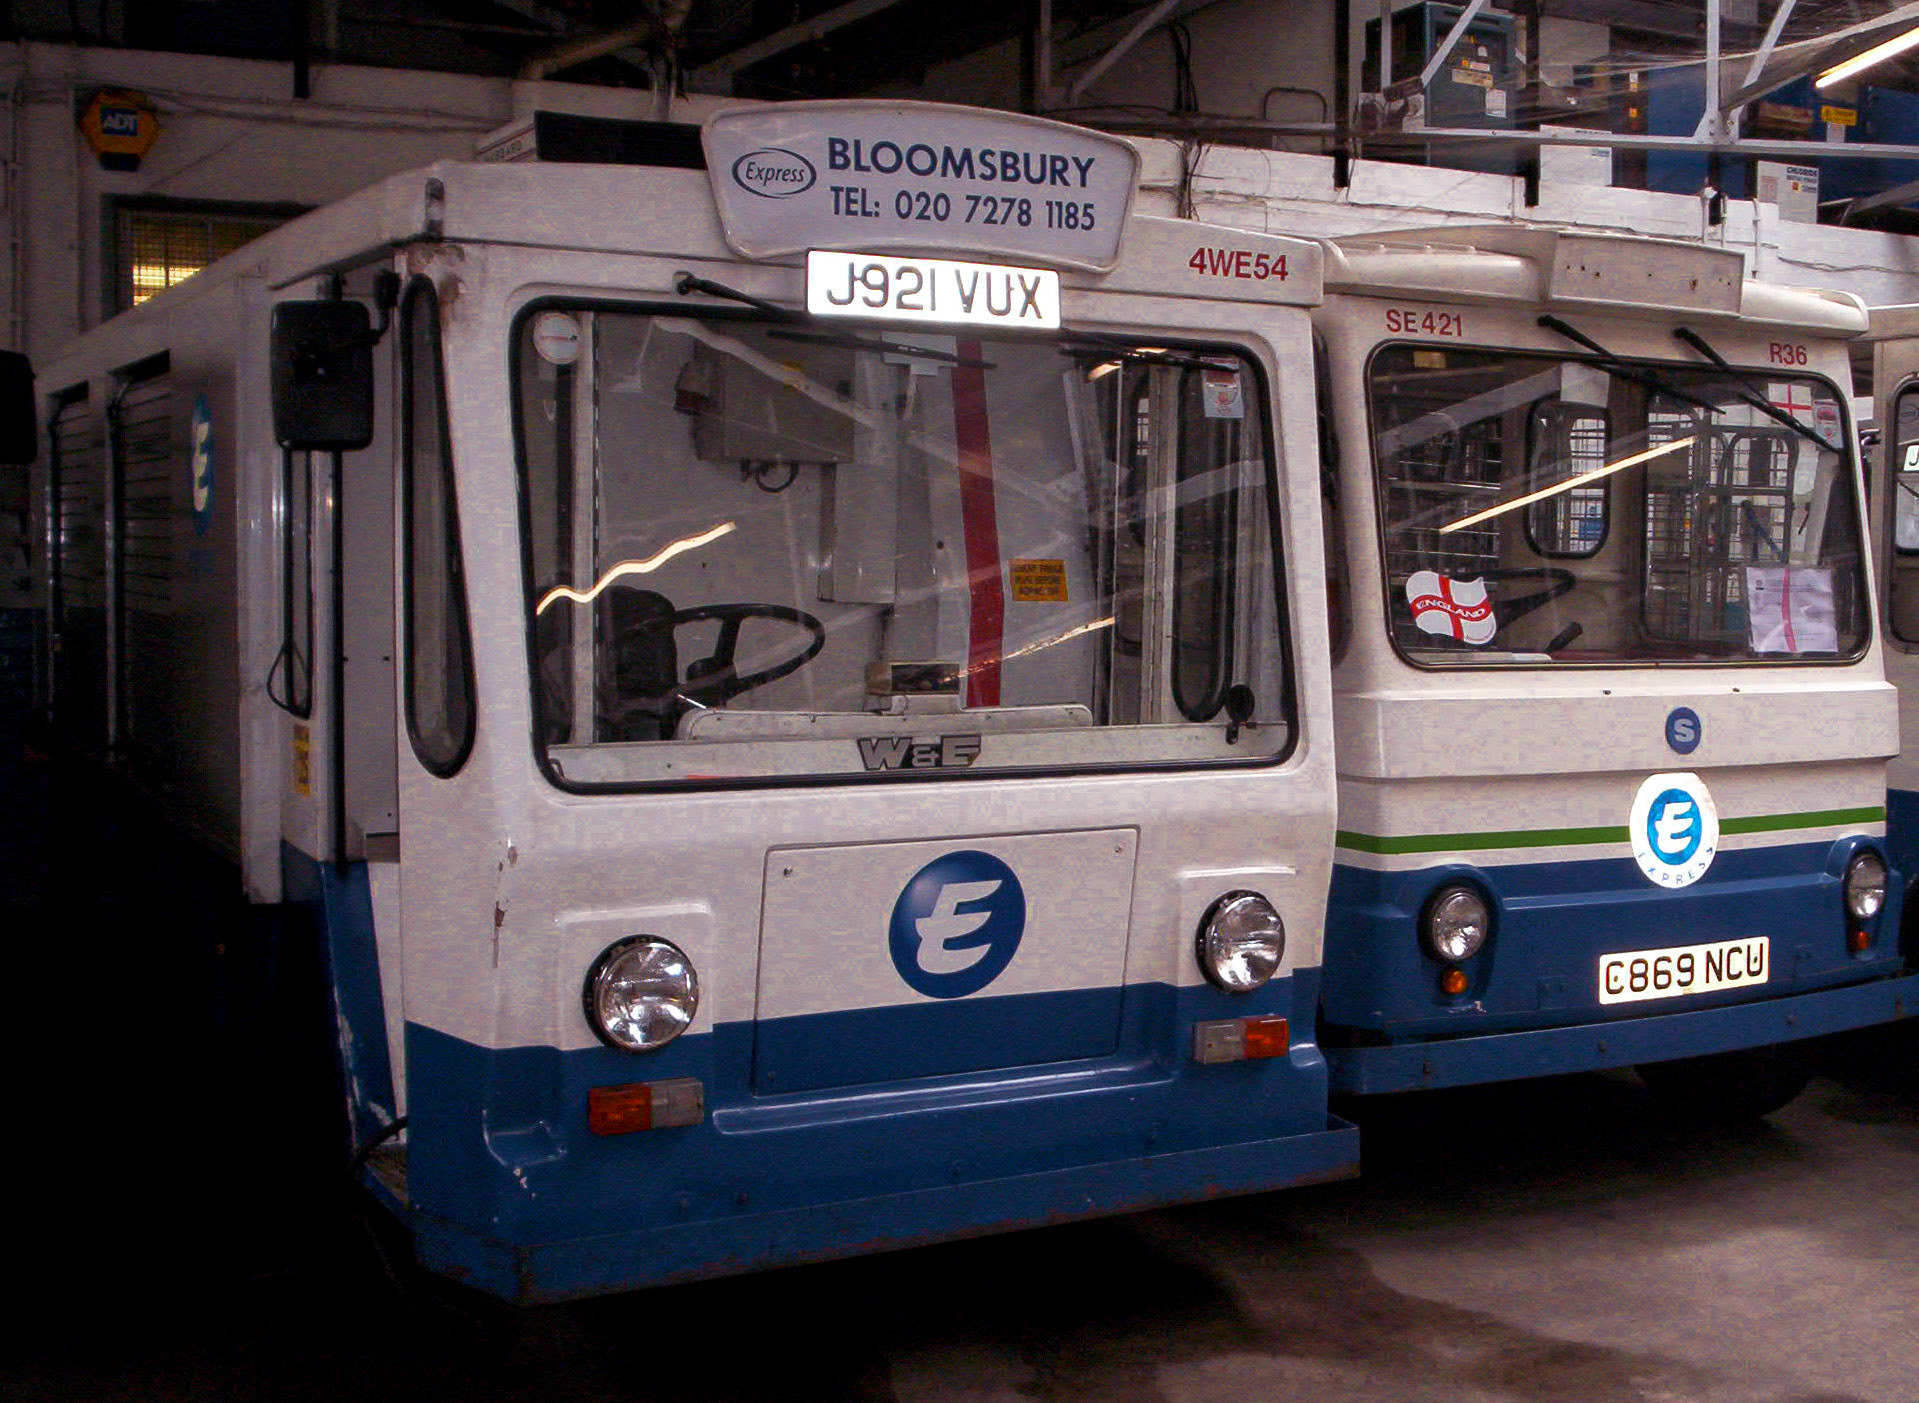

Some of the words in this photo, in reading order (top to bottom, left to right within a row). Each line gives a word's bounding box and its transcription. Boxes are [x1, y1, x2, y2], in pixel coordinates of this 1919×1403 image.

[102, 113, 137, 130] ADT
[745, 162, 804, 186] Express
[828, 137, 1095, 187] BLOOMSBURY
[830, 186, 880, 217] TEL:
[895, 190, 950, 221] 020
[965, 195, 1032, 227] 7278
[1046, 200, 1095, 231] 1185
[1189, 248, 1289, 281] 4WE54
[827, 262, 937, 313] J921
[955, 269, 1042, 319] VUX
[1386, 309, 1462, 337] SE421
[1770, 343, 1807, 365] R36
[1416, 600, 1486, 618] ENGLAND
[1674, 719, 1695, 742] S
[1606, 961, 1694, 994] C869
[1706, 943, 1763, 983] NCU
